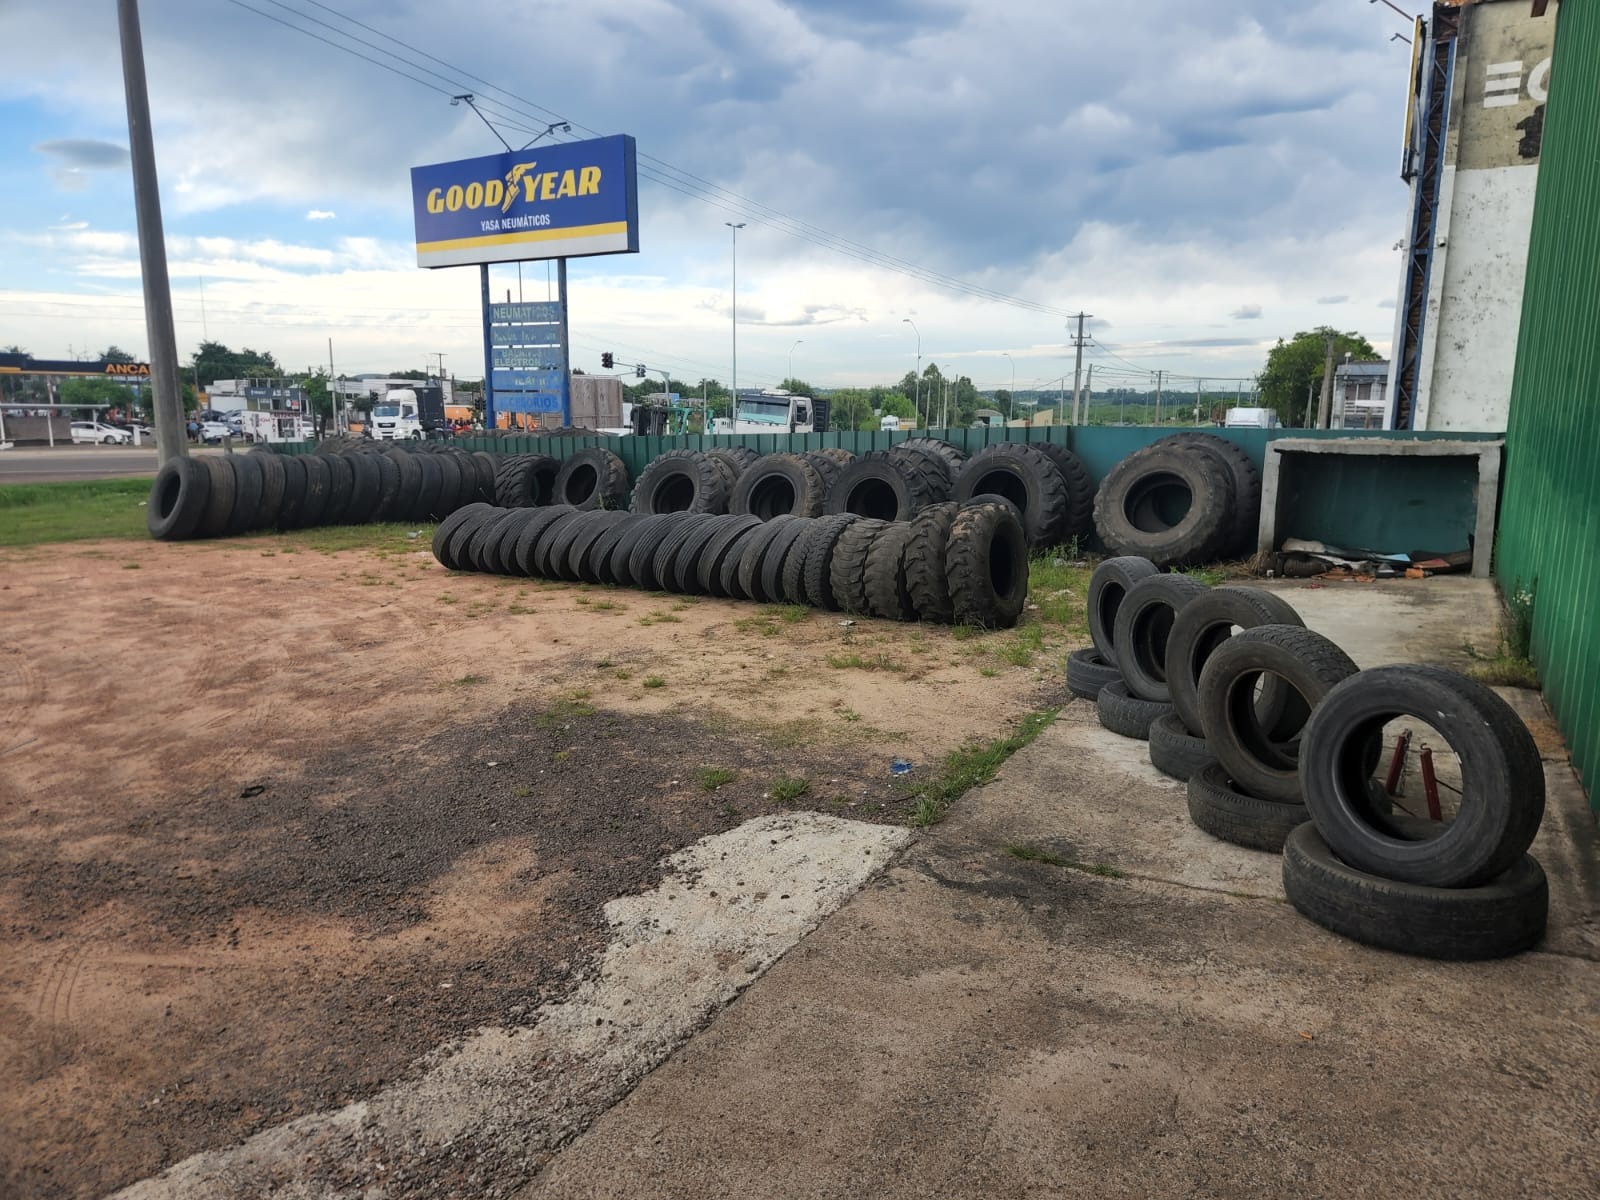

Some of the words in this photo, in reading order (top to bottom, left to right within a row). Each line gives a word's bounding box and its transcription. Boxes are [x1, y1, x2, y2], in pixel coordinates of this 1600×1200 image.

[480, 219, 500, 232] YASA
[501, 214, 551, 230] NEUMÁTICOS
[105, 363, 151, 375] ANCA
